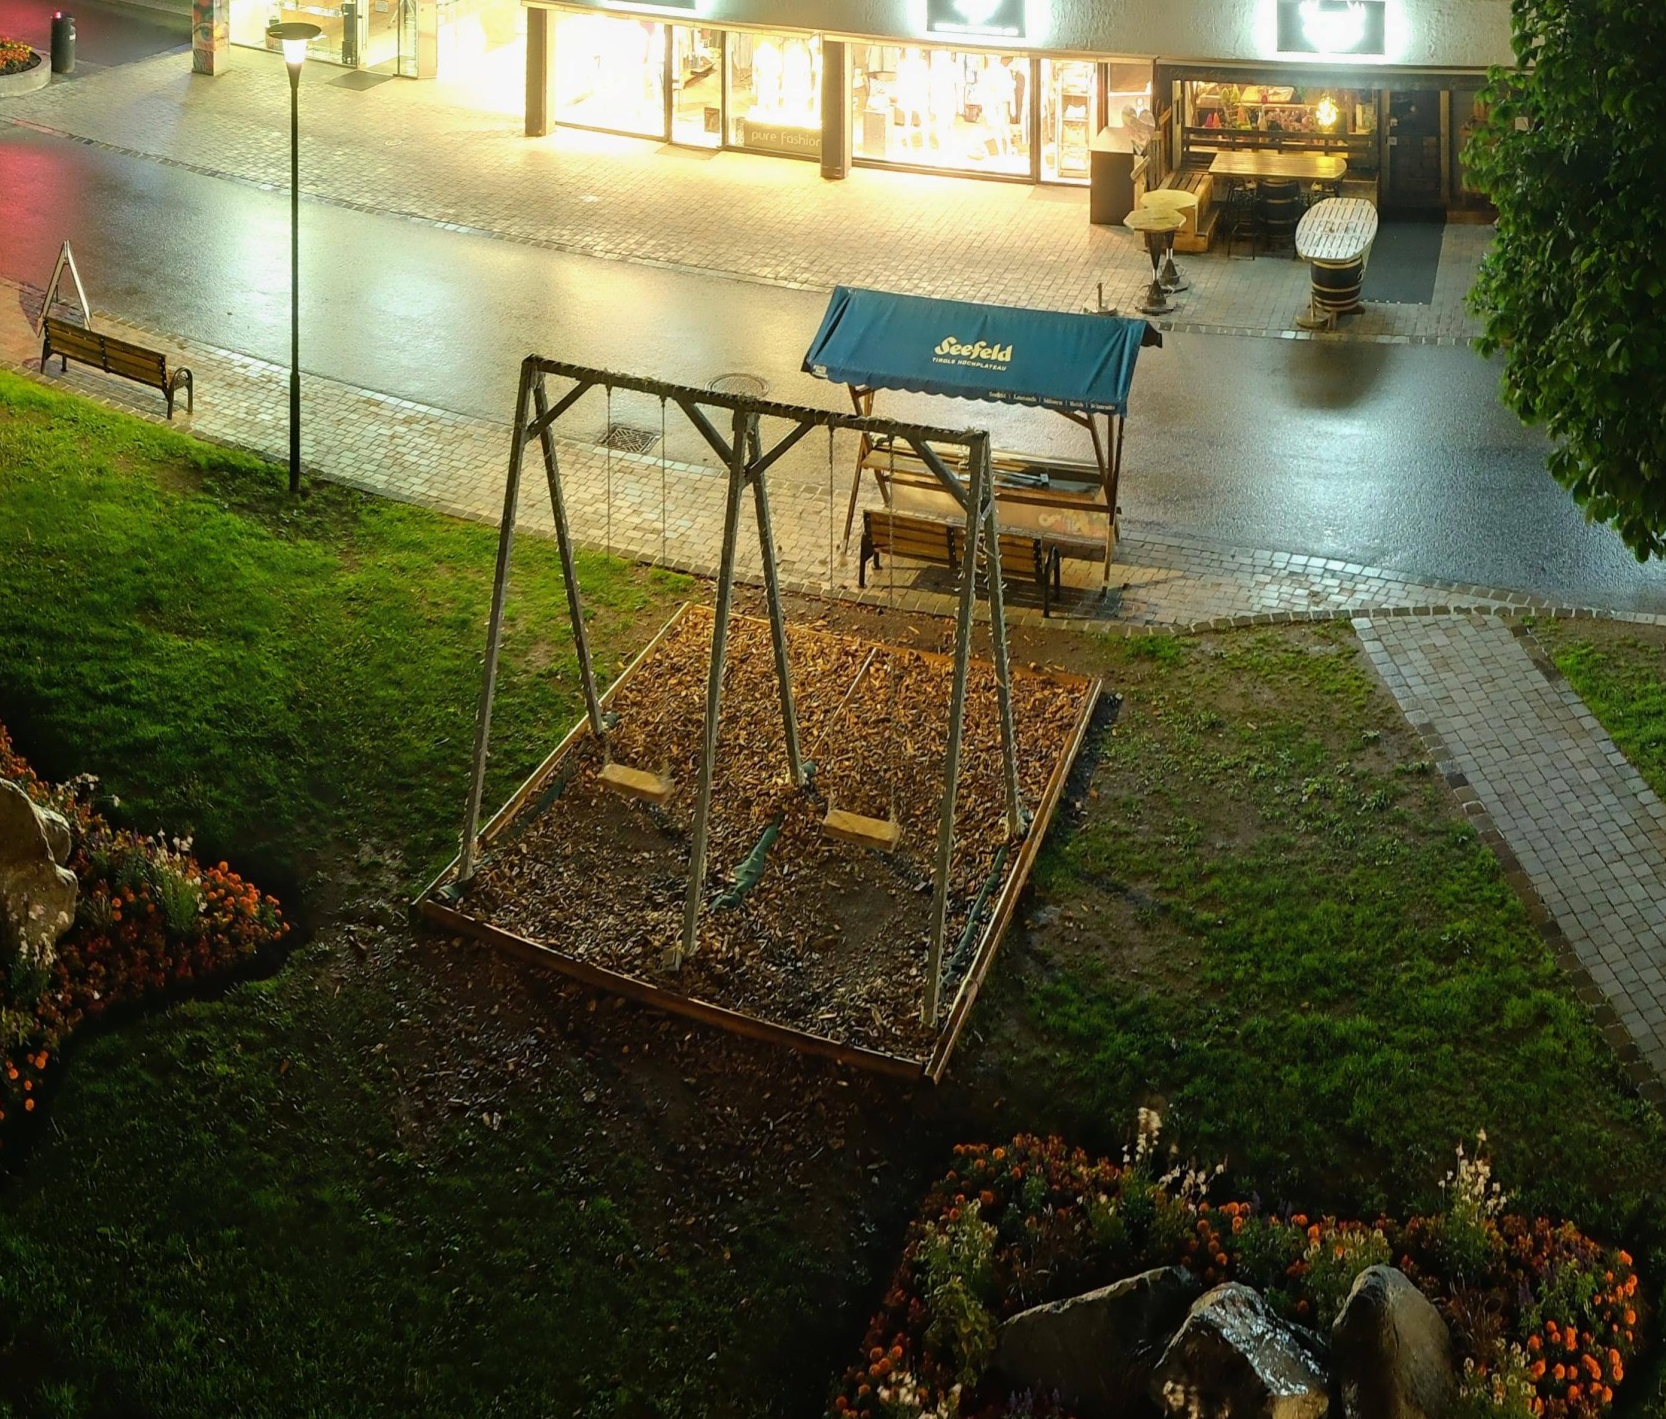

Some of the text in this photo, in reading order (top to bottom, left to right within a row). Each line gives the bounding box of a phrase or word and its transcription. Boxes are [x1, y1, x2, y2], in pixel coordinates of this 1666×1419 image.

[751, 130, 777, 143] pure
[934, 336, 1013, 362] Seefeld
[957, 360, 1007, 371] HOCHPLATEAU
